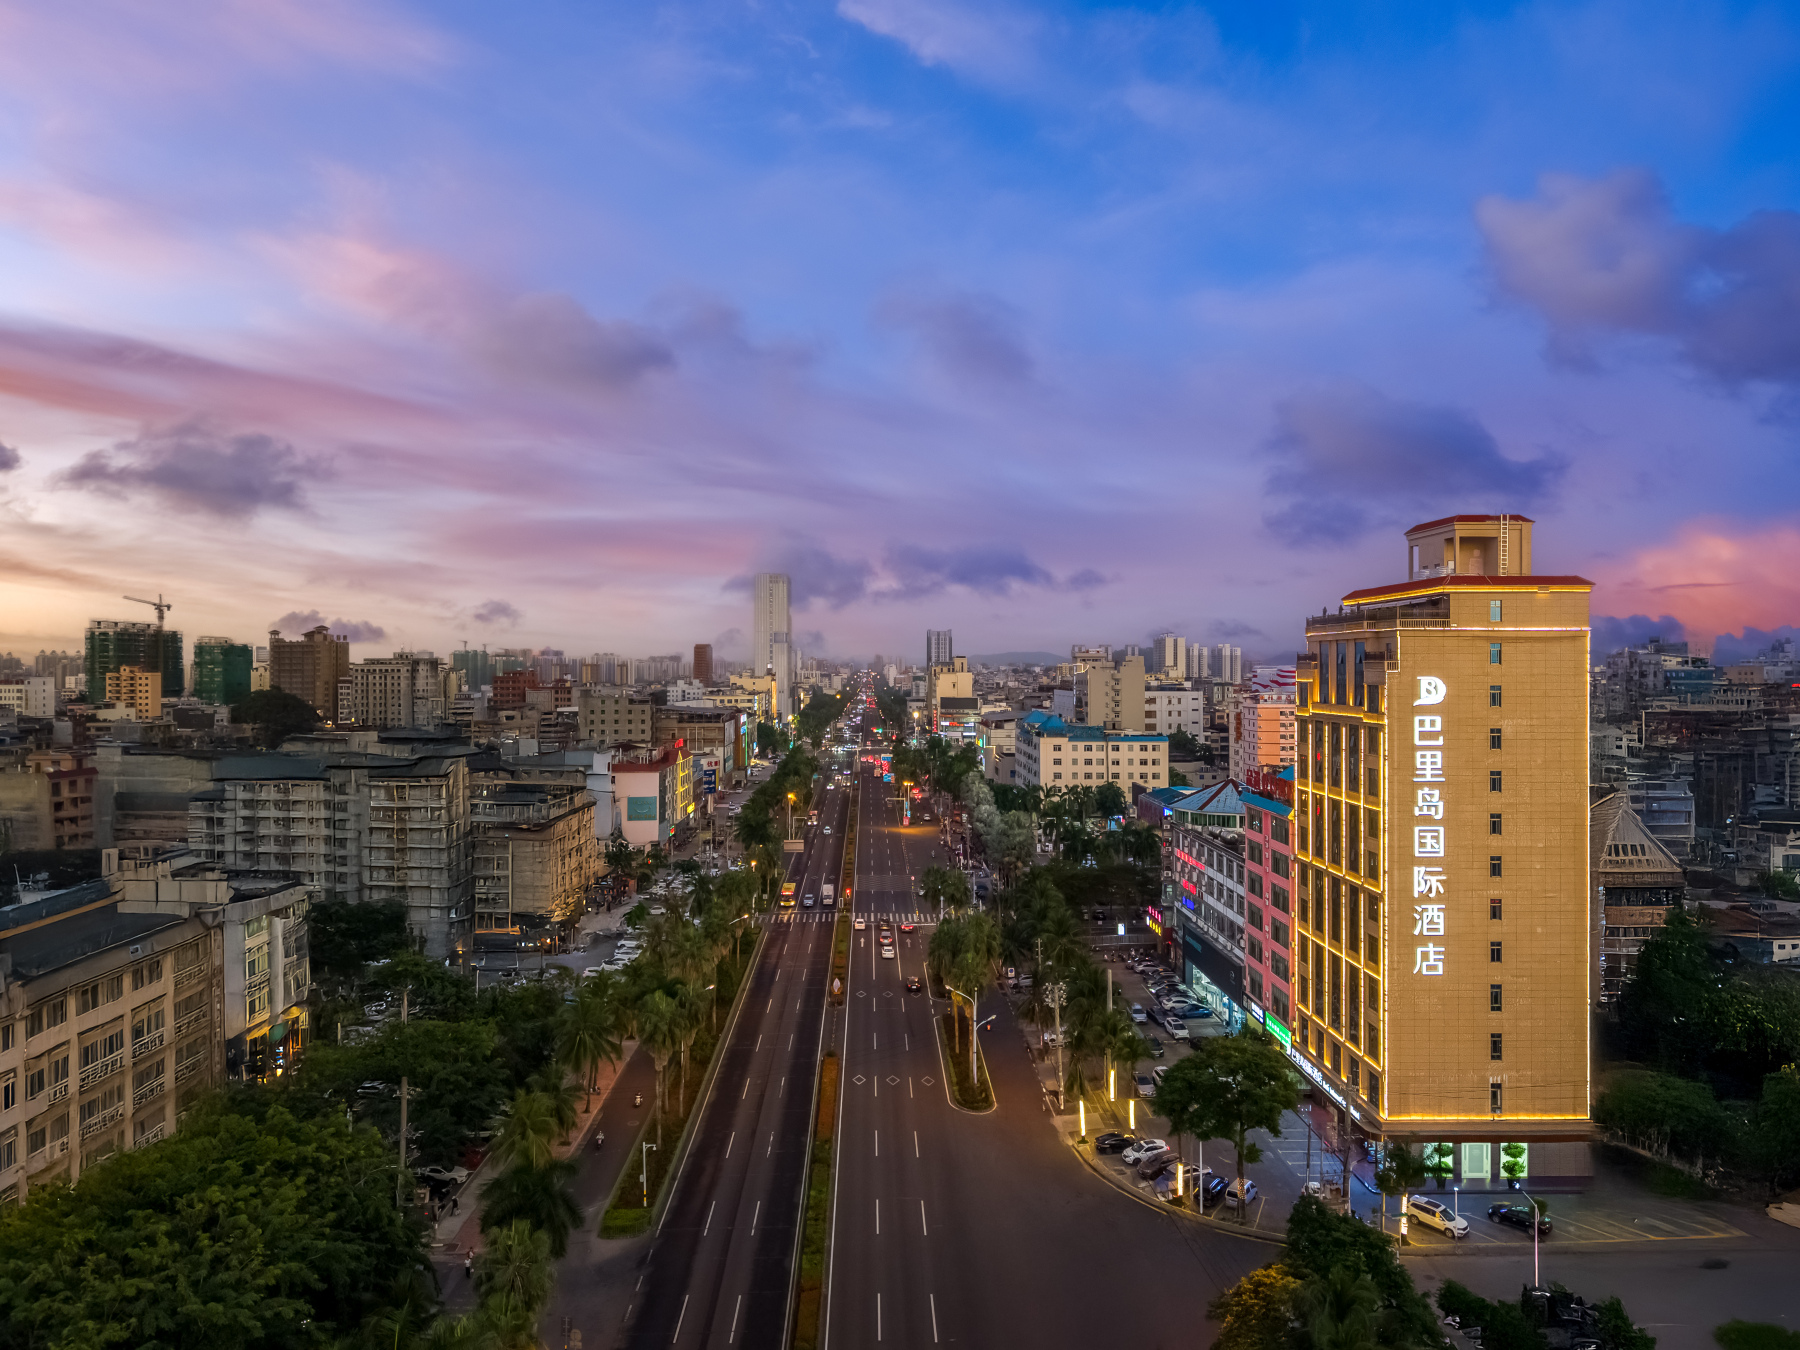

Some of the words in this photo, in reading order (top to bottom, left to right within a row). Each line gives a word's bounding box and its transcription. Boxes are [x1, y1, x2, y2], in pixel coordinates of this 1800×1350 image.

[1413, 715, 1446, 975] 巴里岛国际酒店
